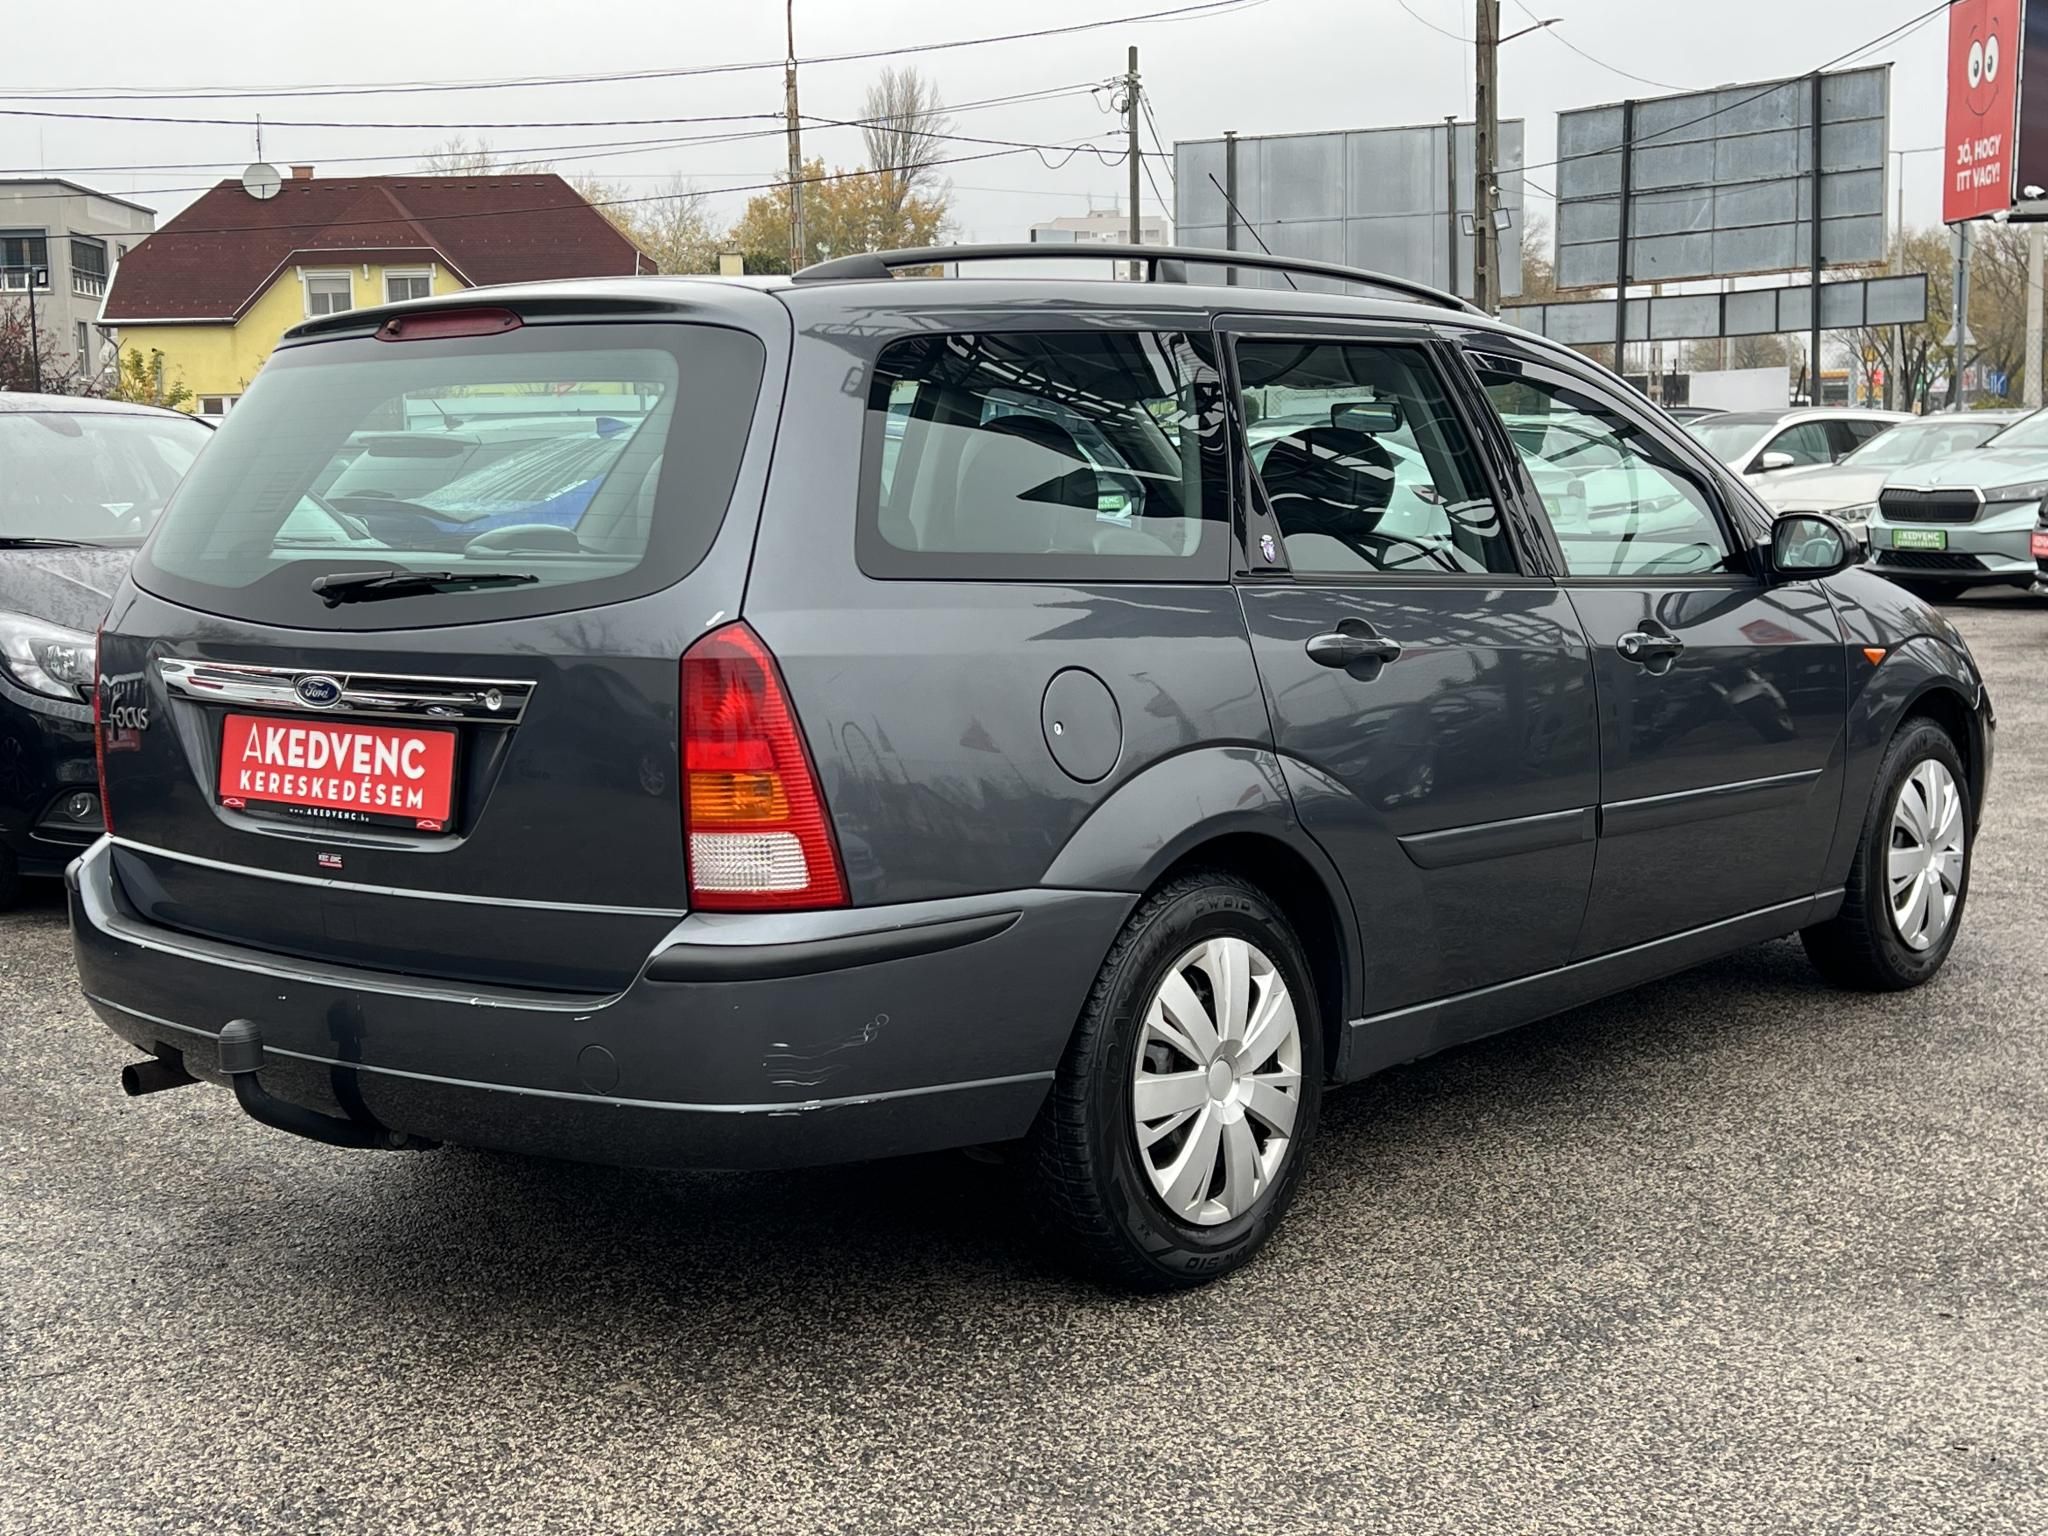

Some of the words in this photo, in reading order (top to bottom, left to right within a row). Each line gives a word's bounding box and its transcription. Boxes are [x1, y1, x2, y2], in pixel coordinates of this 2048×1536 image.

[1957, 138, 1972, 166] JÓ,
[1974, 134, 2001, 161] HOGY
[1956, 170, 1972, 192] ITT
[1973, 162, 2000, 187] VAGY!
[305, 681, 330, 699] Ford
[239, 770, 424, 809] KERESKEDÉSEM
